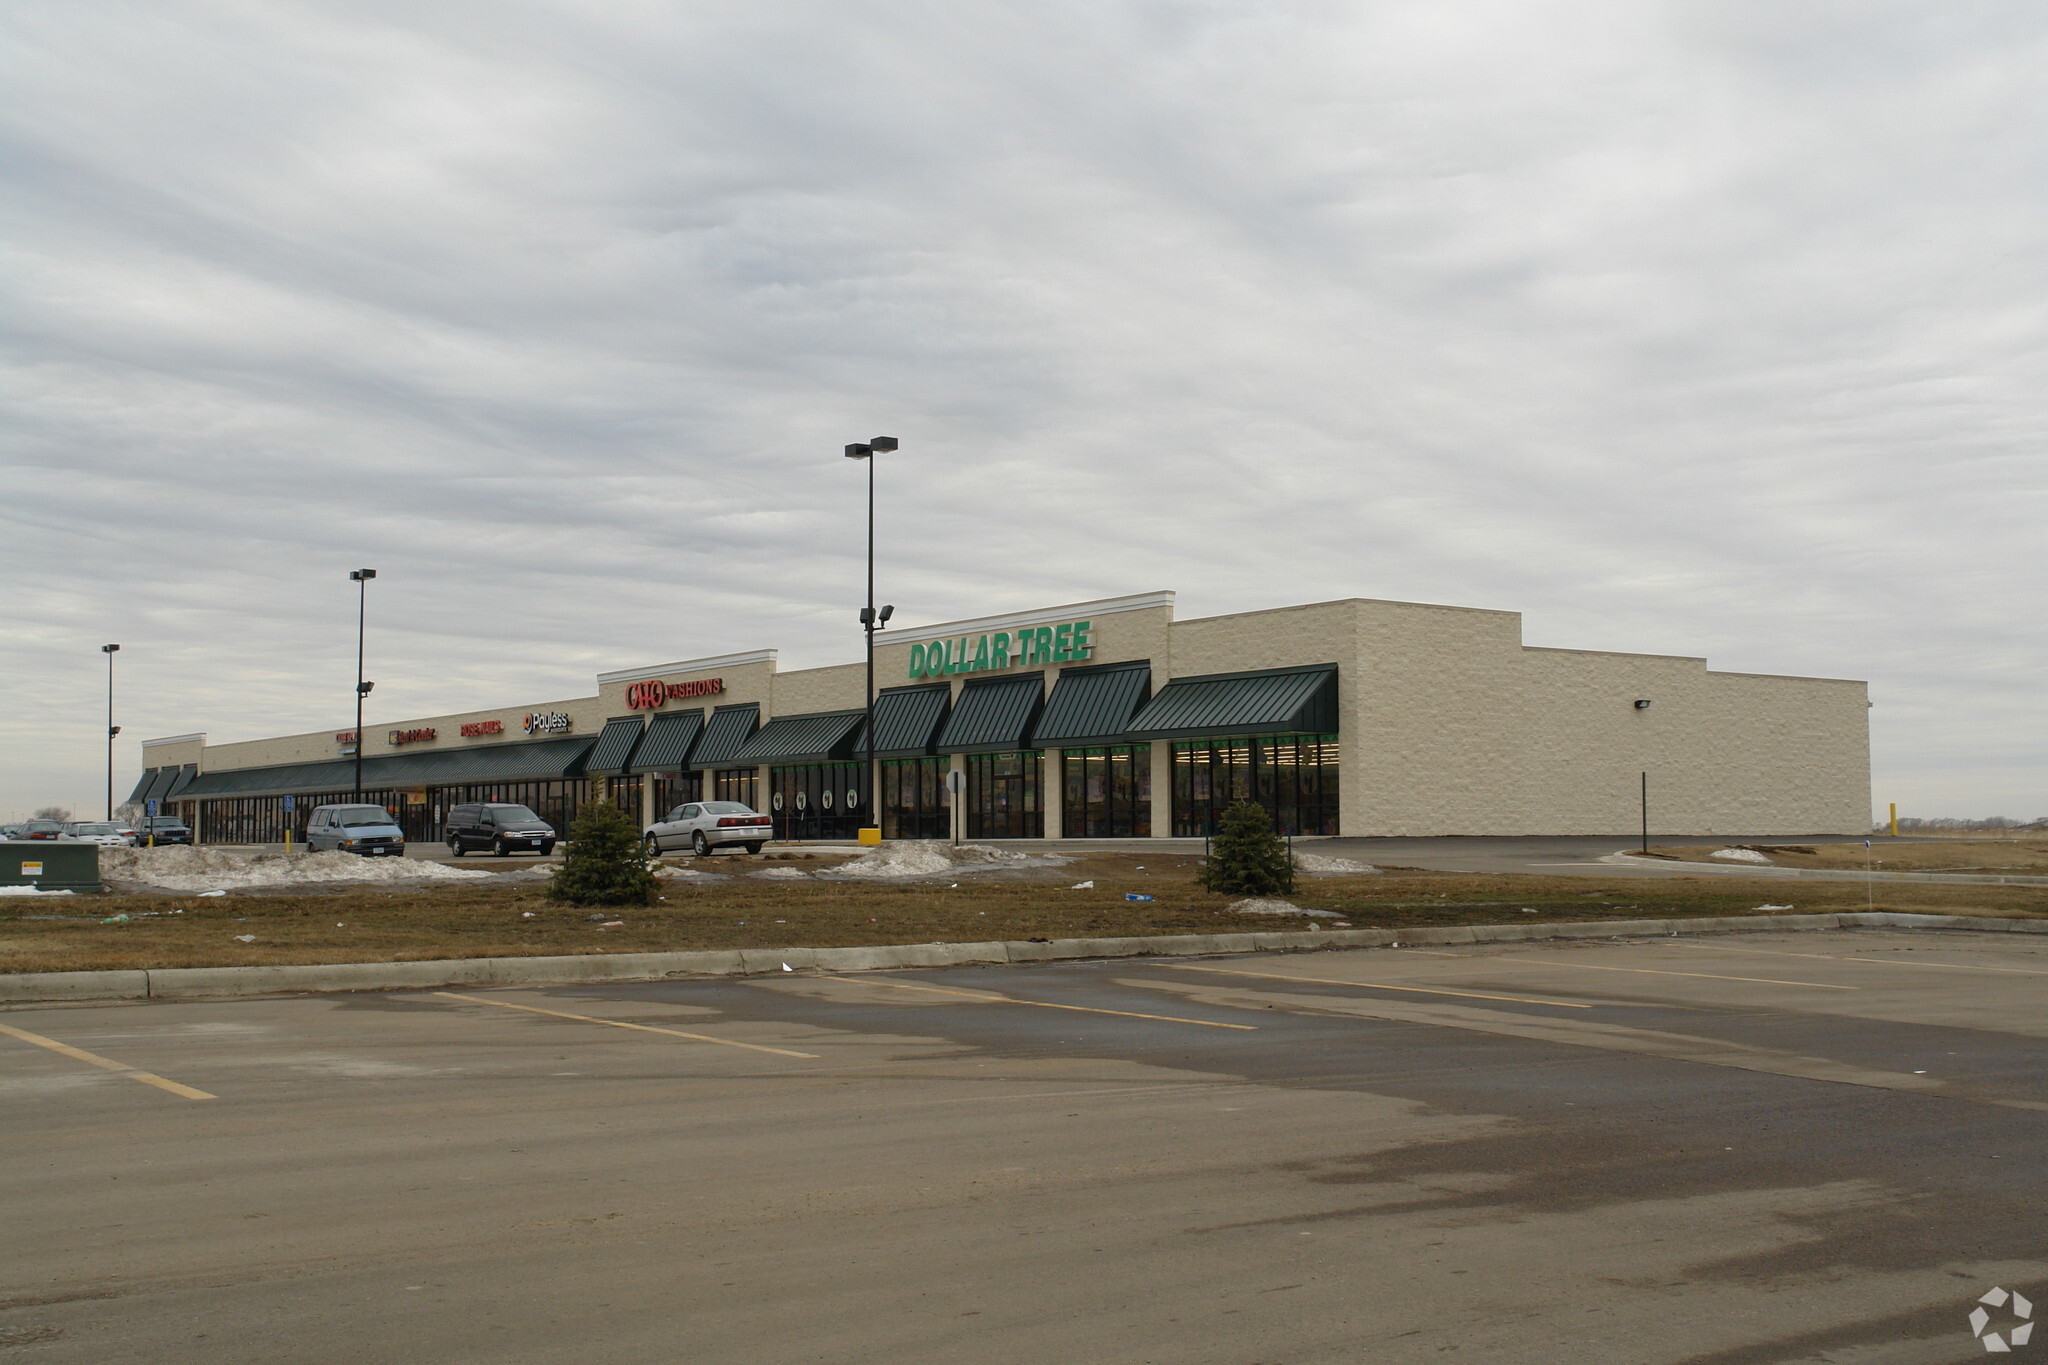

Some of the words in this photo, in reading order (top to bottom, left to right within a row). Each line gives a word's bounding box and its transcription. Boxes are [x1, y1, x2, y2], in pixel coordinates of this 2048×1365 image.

[909, 632, 1012, 679] DOLLAR
[1018, 621, 1093, 666] TREE
[625, 680, 665, 709] CATO
[666, 678, 722, 699] FASHIONS
[533, 712, 568, 733] Payless
